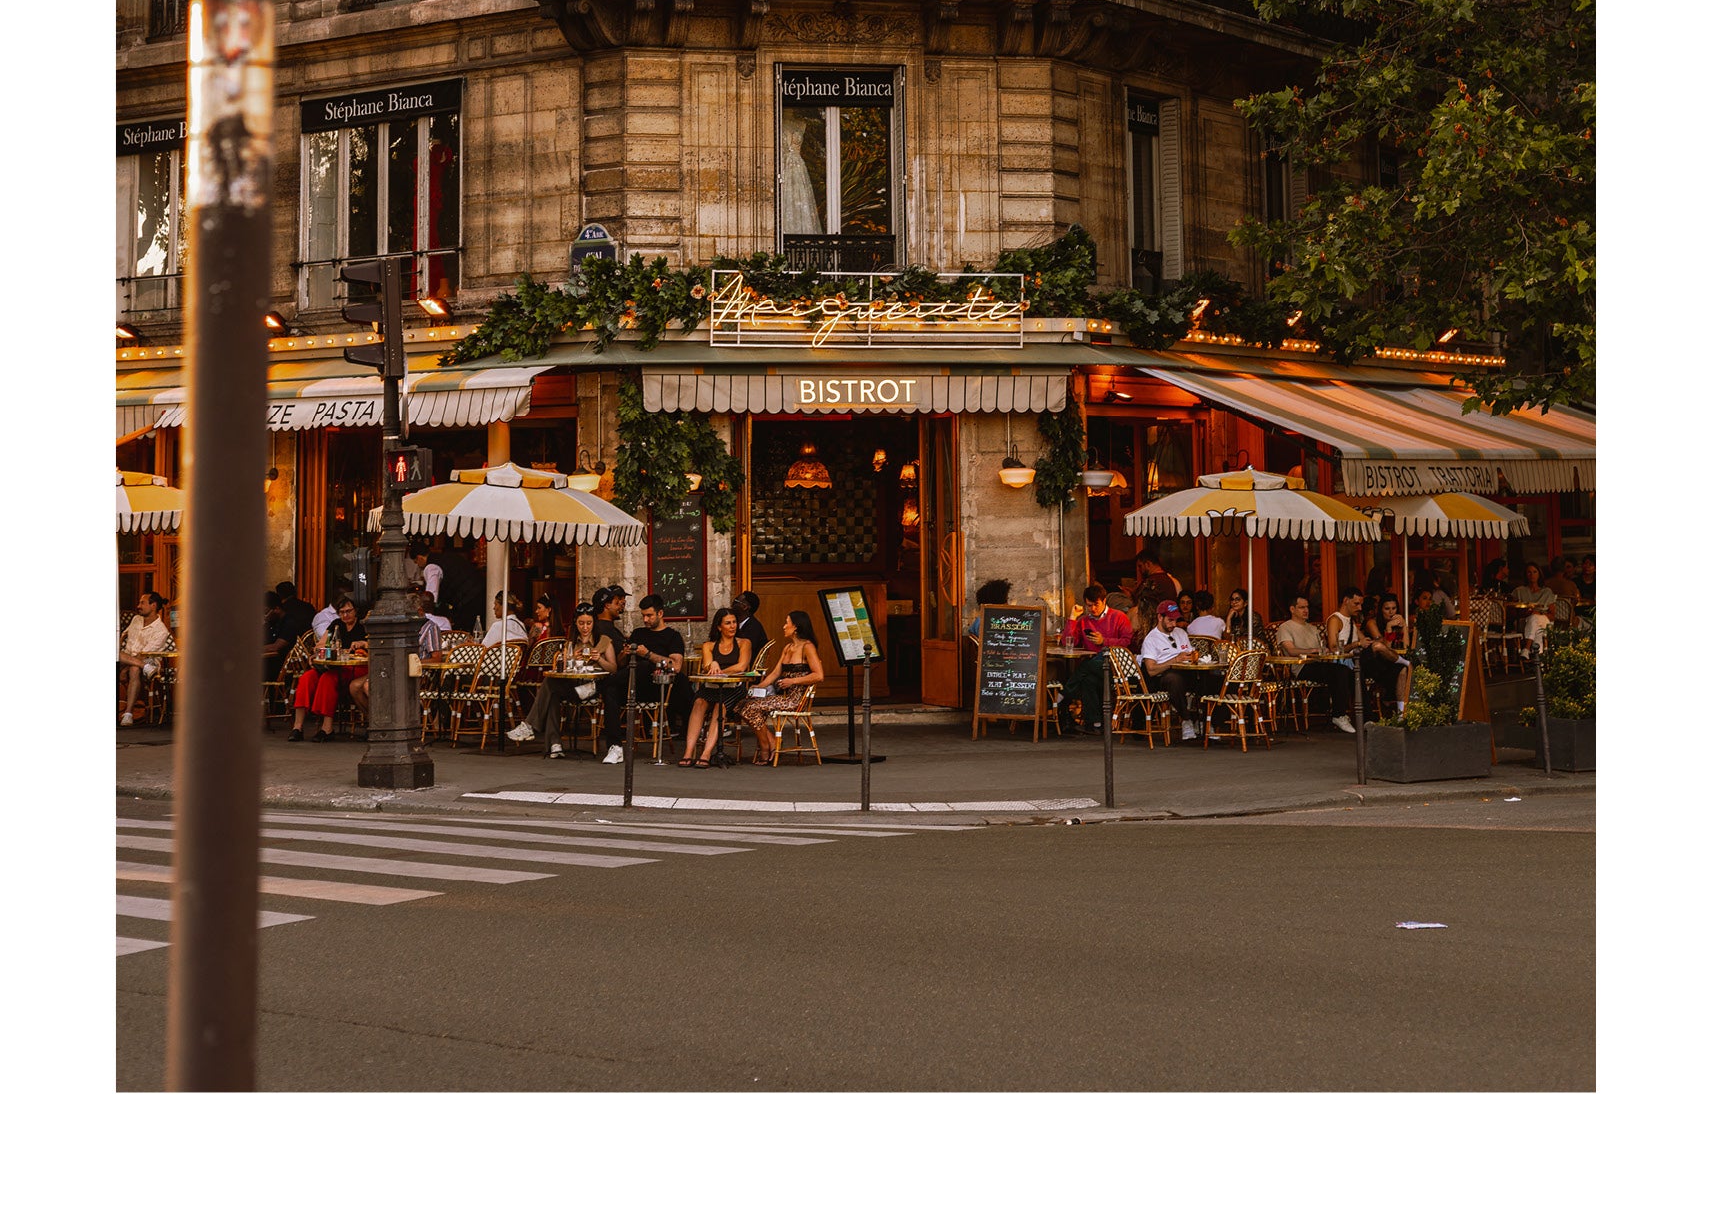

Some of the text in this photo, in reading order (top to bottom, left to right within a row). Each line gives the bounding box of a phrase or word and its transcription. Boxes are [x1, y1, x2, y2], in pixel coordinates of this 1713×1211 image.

[781, 76, 893, 100] téphane Bianca
[324, 92, 433, 122] Stéphane Bianca
[123, 121, 176, 147] Stéphane
[714, 274, 1023, 347] Marguerite
[800, 379, 917, 404] BISTROT
[311, 400, 376, 423] PASTA
[1365, 465, 1494, 489] BISTROT TRATTORIA
